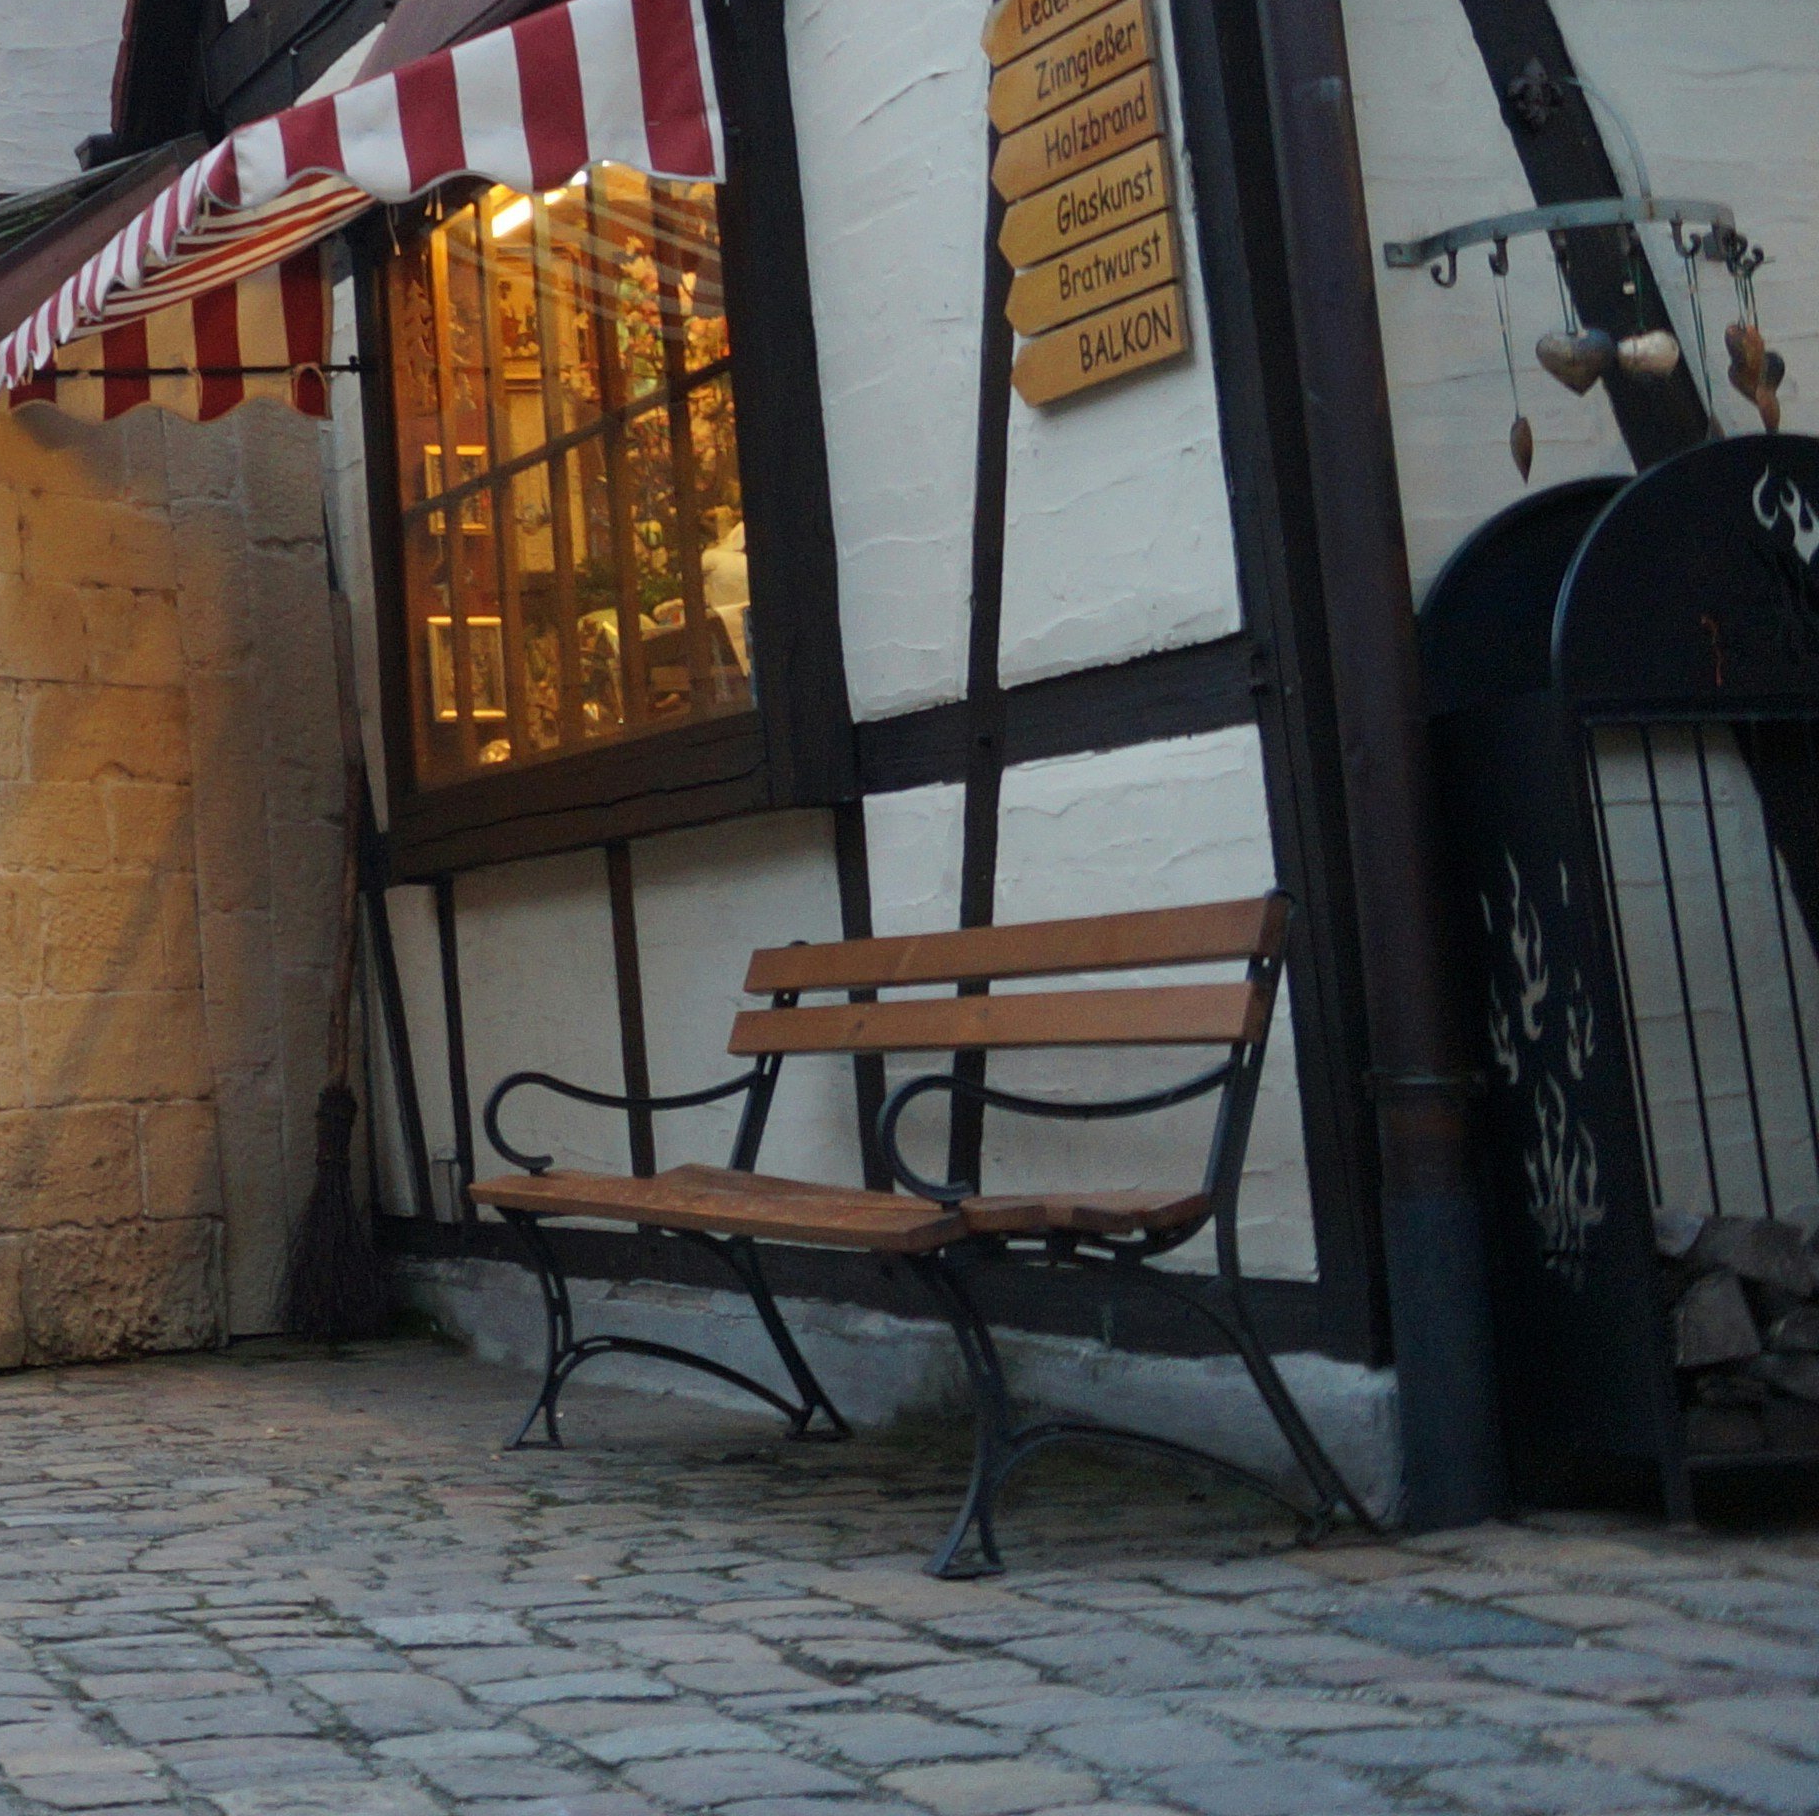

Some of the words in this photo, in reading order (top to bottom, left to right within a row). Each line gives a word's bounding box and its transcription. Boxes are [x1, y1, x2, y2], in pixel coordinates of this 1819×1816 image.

[1035, 20, 1137, 100] Zinngießer
[1044, 80, 1148, 168] Holzbrand
[1057, 161, 1153, 235] Glaskunst
[1058, 228, 1161, 300] Bratwurst
[1079, 304, 1172, 373] BALKON
